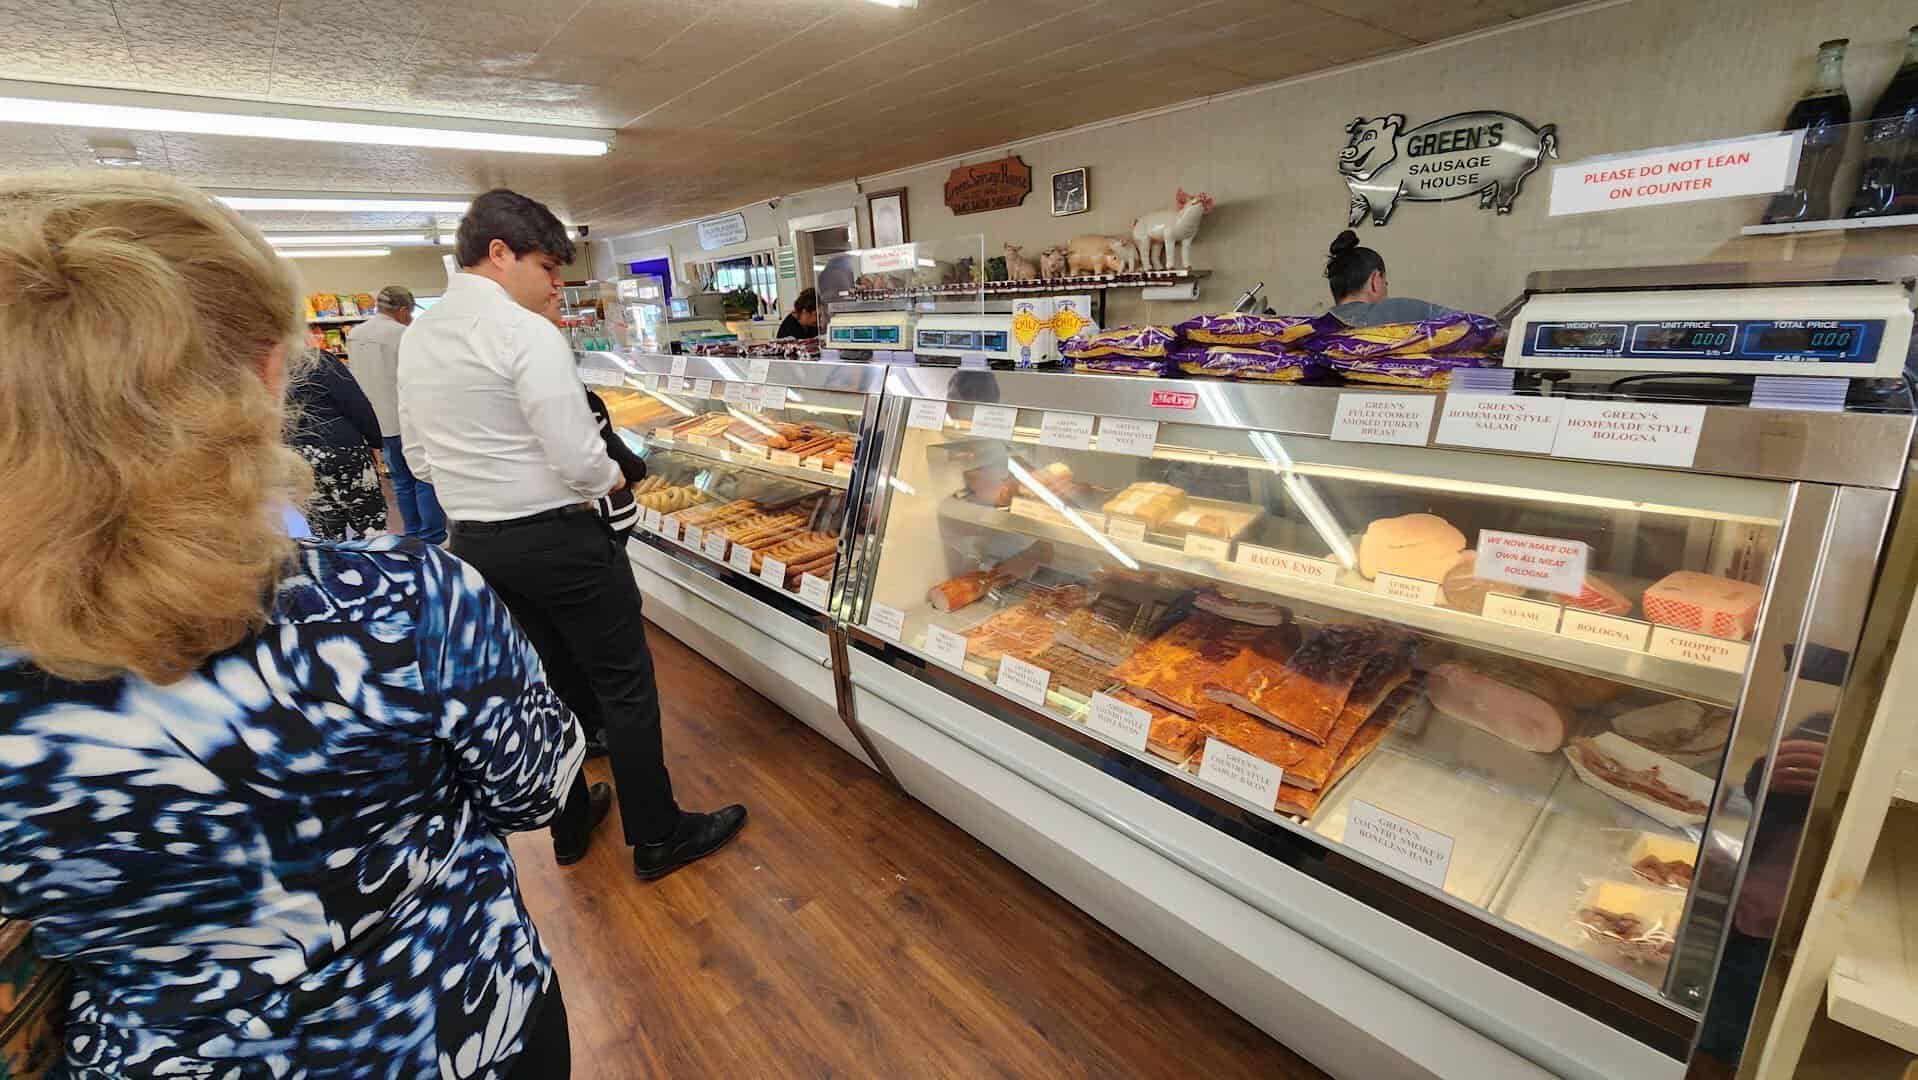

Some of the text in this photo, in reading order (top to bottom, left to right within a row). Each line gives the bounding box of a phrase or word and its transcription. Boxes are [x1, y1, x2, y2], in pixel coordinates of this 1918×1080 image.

[1407, 123, 1503, 158] GREEN'S
[1409, 155, 1492, 176] SAUSAGE
[1584, 152, 1752, 185] PLEASE DO NOT LEAN
[1420, 173, 1480, 190] HOUSE
[1609, 177, 1713, 200] ON COUNTER
[1773, 321, 1839, 329] TOTAL PRICE
[1478, 402, 1525, 411] GREEN'S
[1602, 410, 1659, 420] GREEN'S
[1449, 410, 1551, 423] HOMEMADE STYLE
[1477, 422, 1518, 431] SALAMI
[1567, 418, 1692, 434] HOMEMADE STYLE
[1592, 430, 1657, 443] BOLOGNA
[1487, 537, 1580, 555] WE NOW MAKE OUR
[1250, 553, 1323, 577] BACON ENDS
[1495, 551, 1565, 567] OWN ALL MEAT
[1503, 566, 1549, 578] BOLOGNA
[1501, 607, 1540, 621] SALAMI
[1577, 623, 1630, 641] BOLOGNA
[1669, 637, 1729, 656] CHOPPED
[1681, 649, 1712, 662] HAM
[1378, 818, 1420, 840] GREEN'S
[1353, 816, 1444, 861] COUNTRY SMOKED
[1359, 829, 1432, 866] BONELESS HAM
